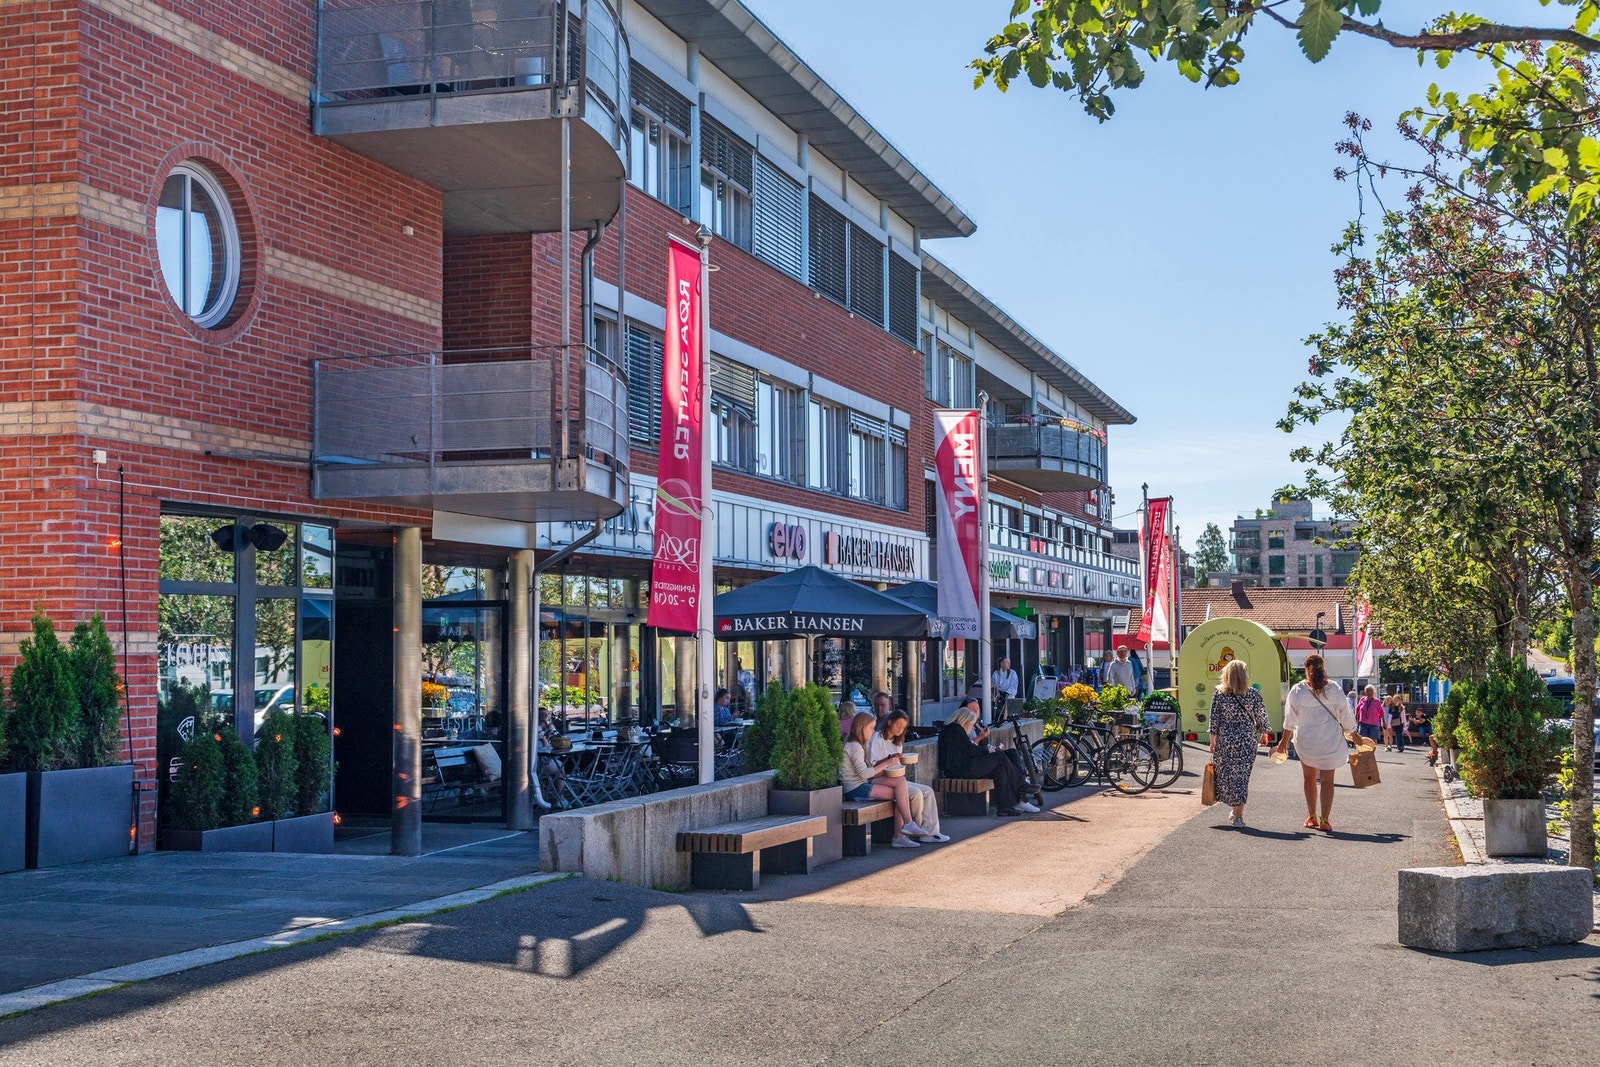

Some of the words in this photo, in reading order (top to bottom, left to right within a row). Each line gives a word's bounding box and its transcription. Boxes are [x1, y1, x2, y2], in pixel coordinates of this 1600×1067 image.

[773, 521, 807, 560] evo
[837, 534, 873, 567] BAKER
[875, 540, 915, 573] HANSEN
[734, 616, 789, 632] BAKER
[793, 615, 864, 631] HANSEN
